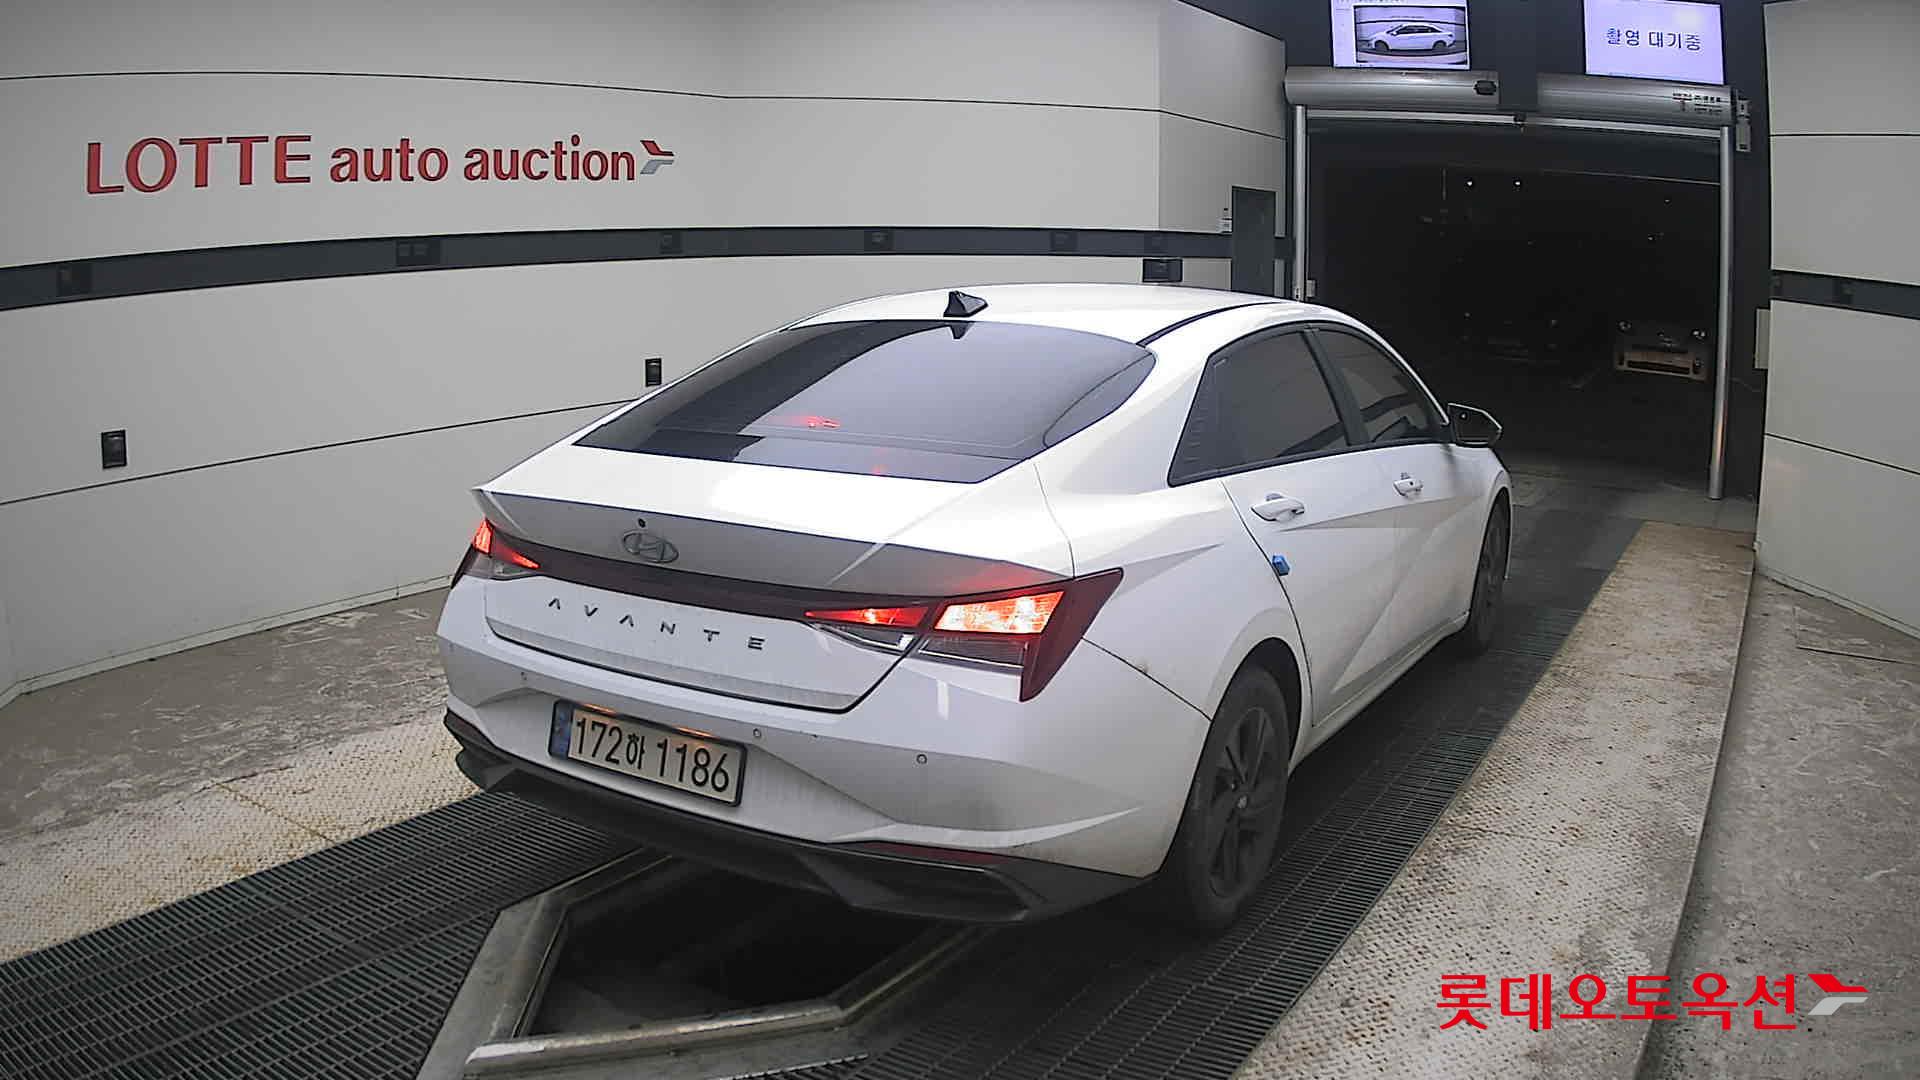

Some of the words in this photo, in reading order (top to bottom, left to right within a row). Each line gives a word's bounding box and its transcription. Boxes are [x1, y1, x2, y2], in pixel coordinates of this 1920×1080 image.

[1607, 28, 1640, 46] 촬영
[1648, 31, 1701, 51] 대기중
[85, 134, 312, 195] LOTTE
[329, 138, 450, 184] auto
[463, 134, 636, 183] auction
[548, 597, 766, 650] AVANTE
[575, 717, 646, 771] 172하
[656, 737, 730, 793] 1186
